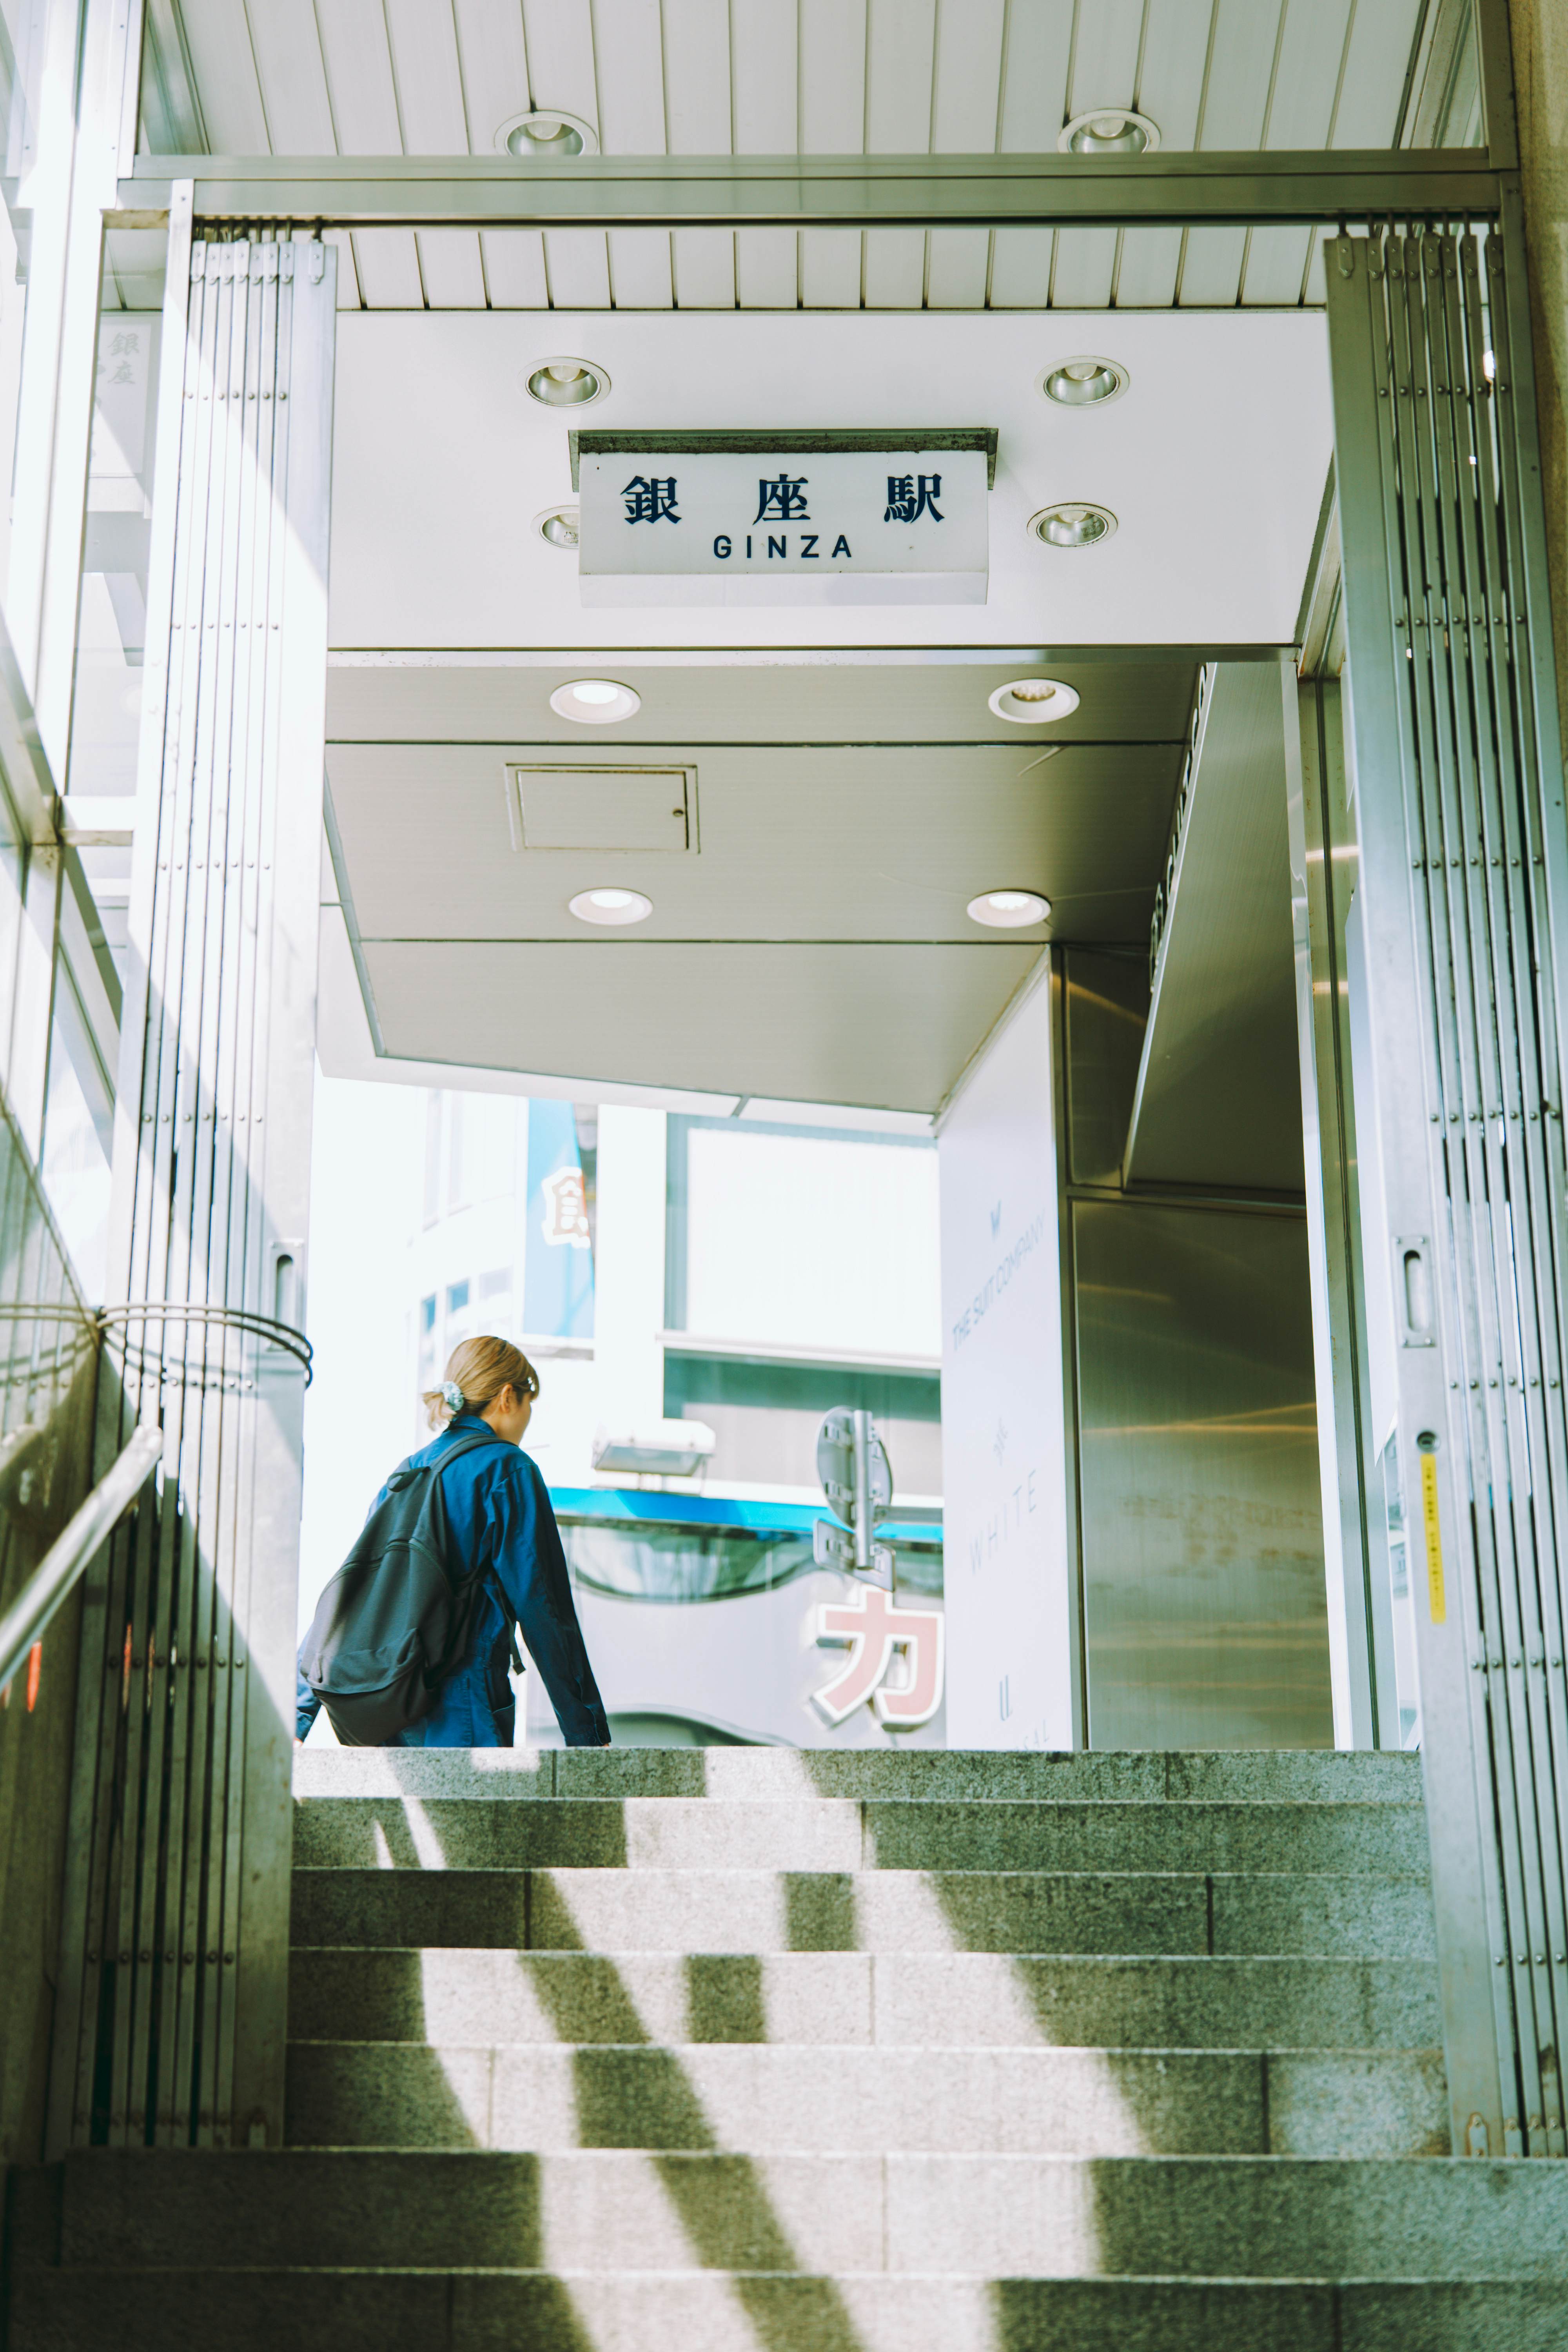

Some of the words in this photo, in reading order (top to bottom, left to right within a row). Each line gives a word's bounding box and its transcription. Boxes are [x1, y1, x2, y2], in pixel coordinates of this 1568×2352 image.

[107, 332, 140, 385] 銀座
[620, 473, 945, 525] 銀座駅
[713, 535, 852, 559] GINZA
[953, 1307, 971, 1350] THE
[973, 1275, 995, 1324] SUIT
[996, 1209, 1045, 1294] COMPANY
[970, 1469, 1036, 1574] WHITE
